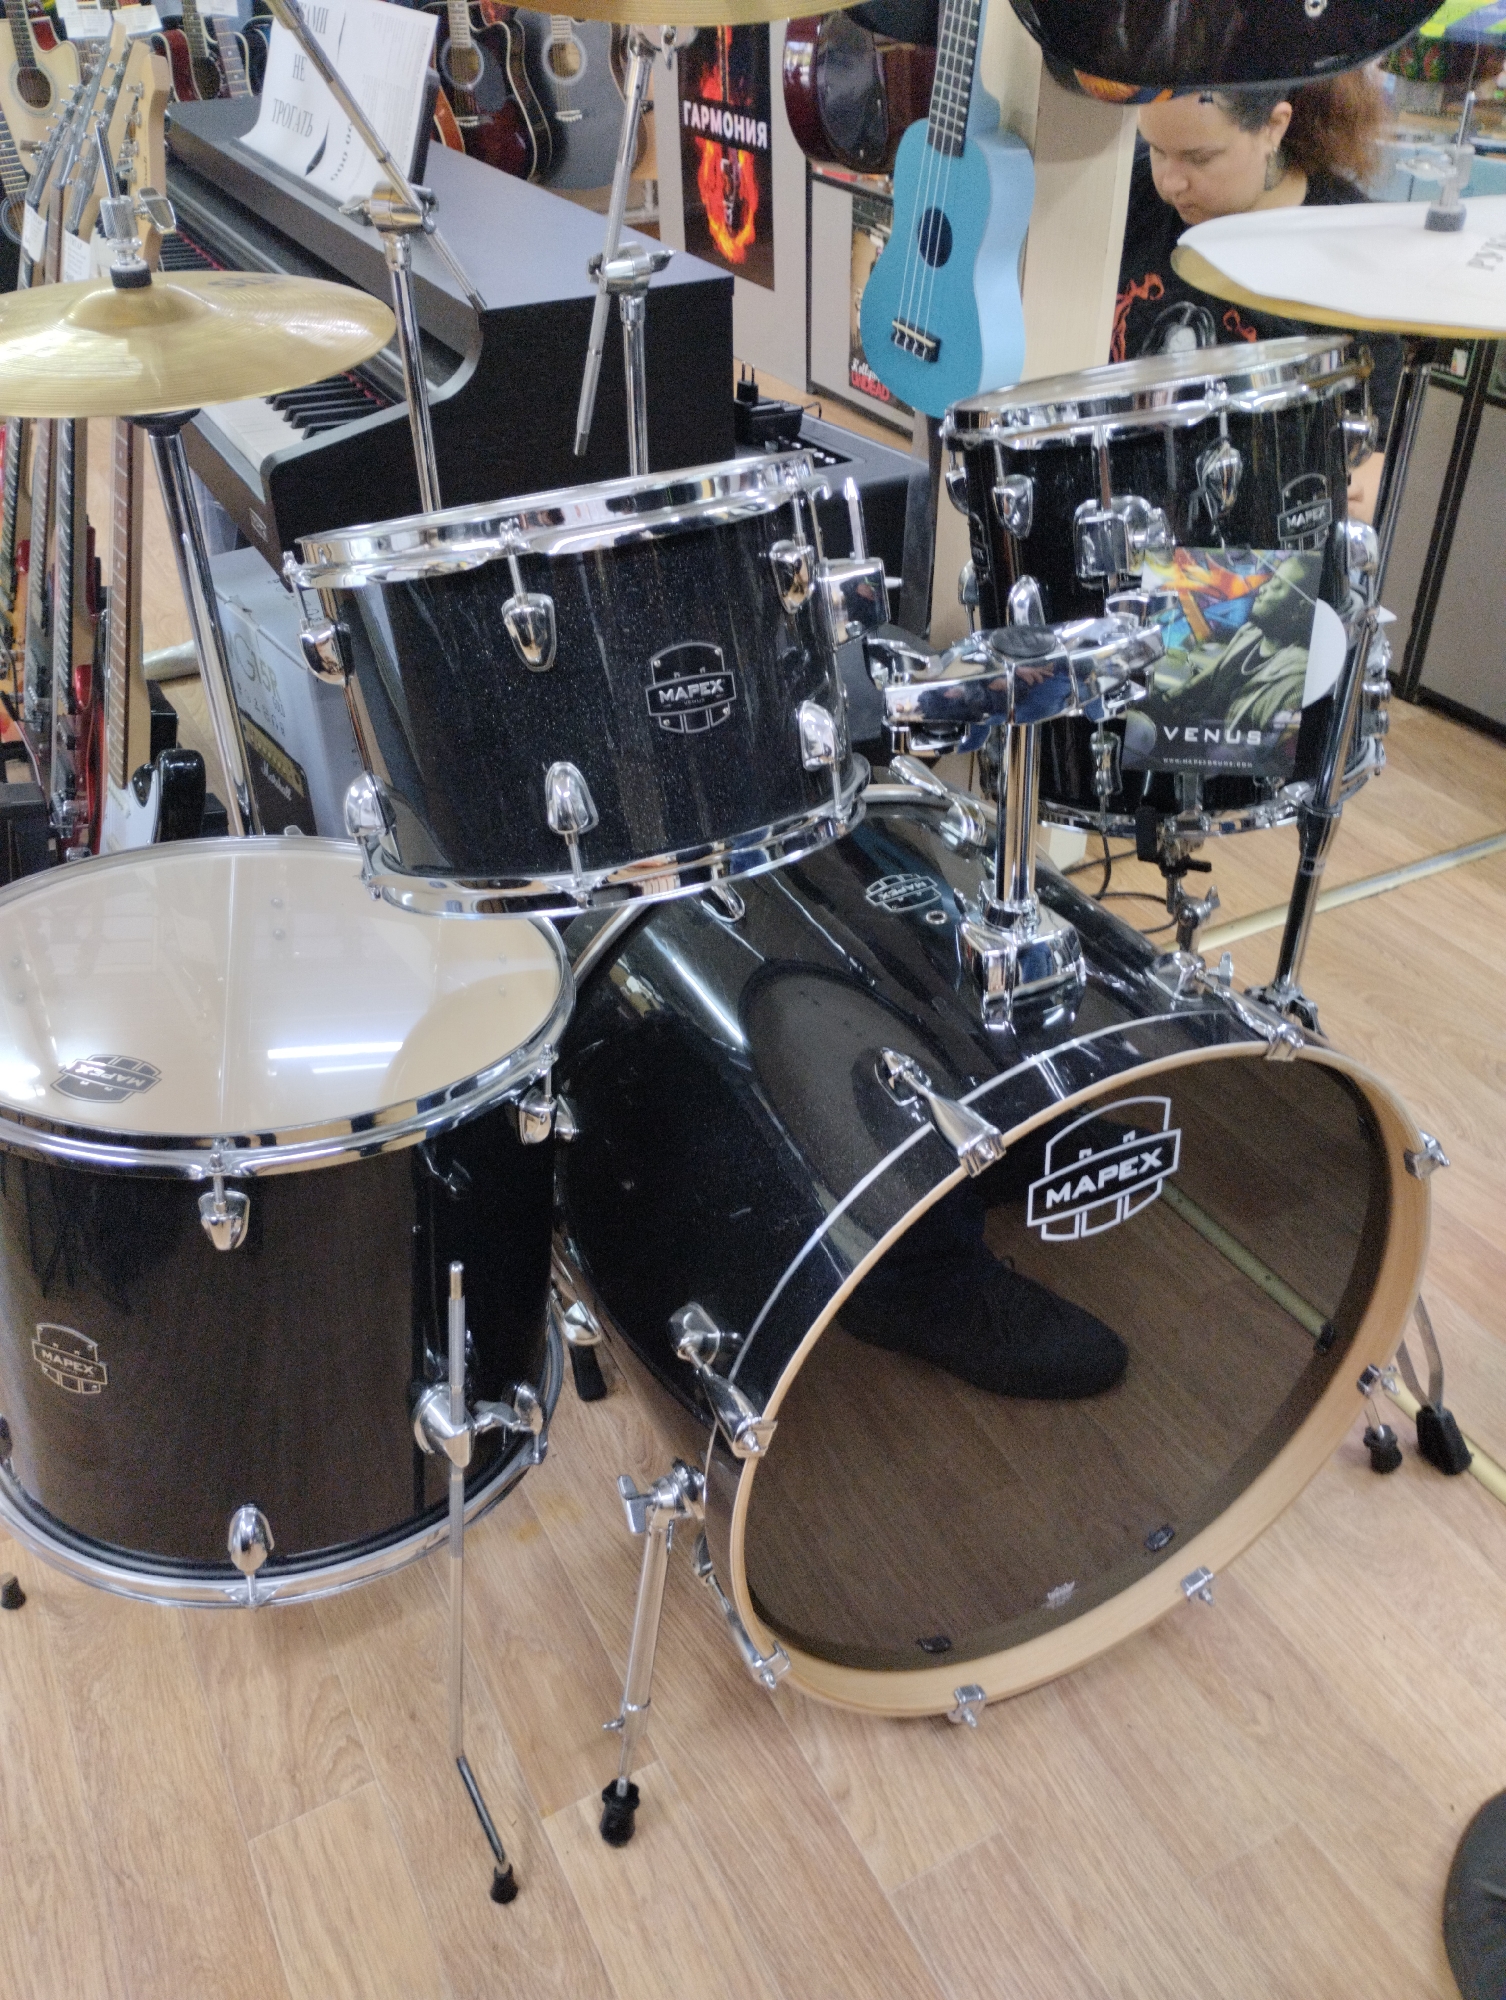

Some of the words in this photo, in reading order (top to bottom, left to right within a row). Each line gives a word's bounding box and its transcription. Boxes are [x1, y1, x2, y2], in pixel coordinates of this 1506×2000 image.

[292, 53, 307, 82] НЕ
[271, 98, 314, 138] ТРОГАТЬ
[683, 100, 768, 149] ГАРМОНИЯ
[1286, 505, 1327, 530] MAPEX
[658, 678, 725, 705] MAPEX
[1163, 725, 1262, 746] VENUS
[75, 1064, 146, 1087] MAPEX
[1046, 1146, 1164, 1209] MAPEX
[41, 1349, 95, 1376] MAPEX
